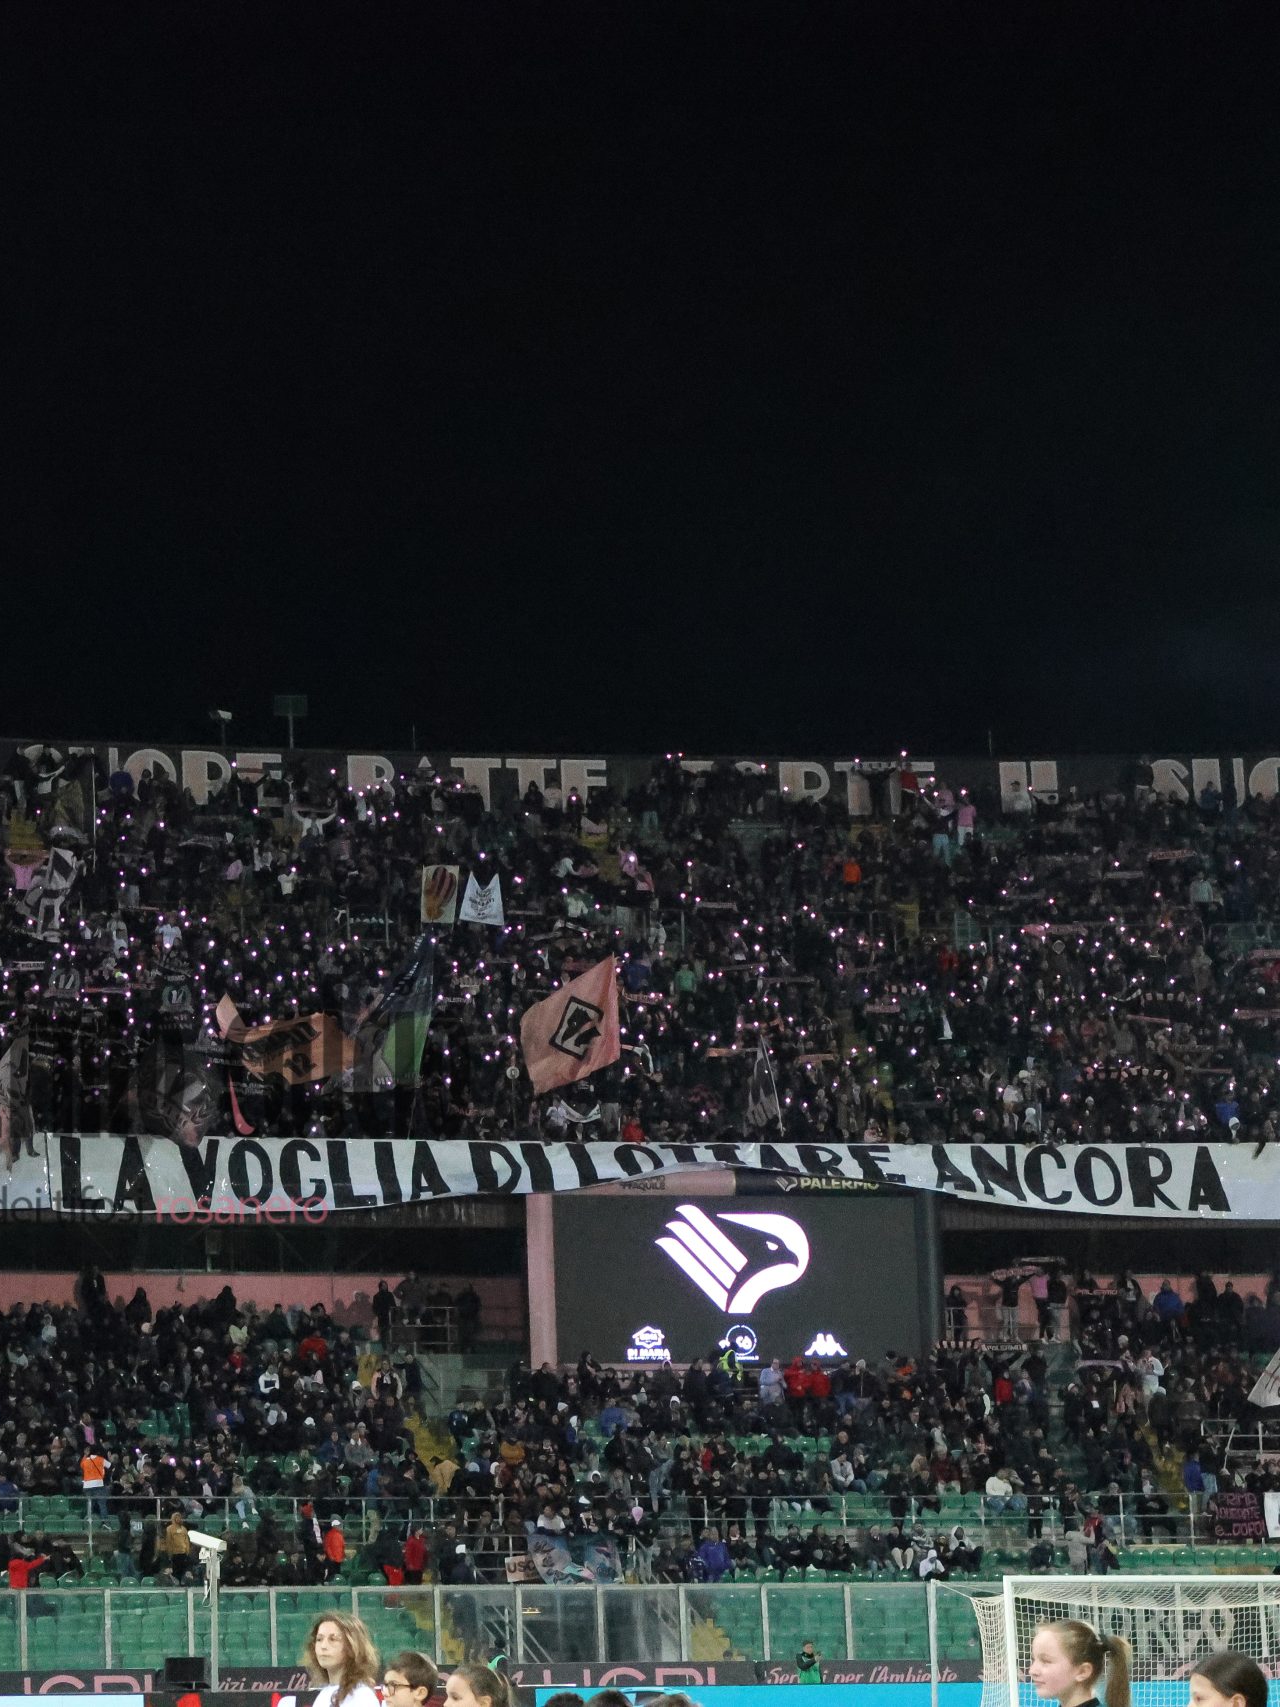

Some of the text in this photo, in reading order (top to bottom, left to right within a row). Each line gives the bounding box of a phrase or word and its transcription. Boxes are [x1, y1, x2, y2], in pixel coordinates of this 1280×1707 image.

[60, 1135, 157, 1212] LA
[176, 1137, 451, 1211] VOGLIA
[469, 1141, 568, 1194] DI
[932, 1144, 1232, 1212] ANCORA
[800, 1178, 879, 1192] PALERMO
